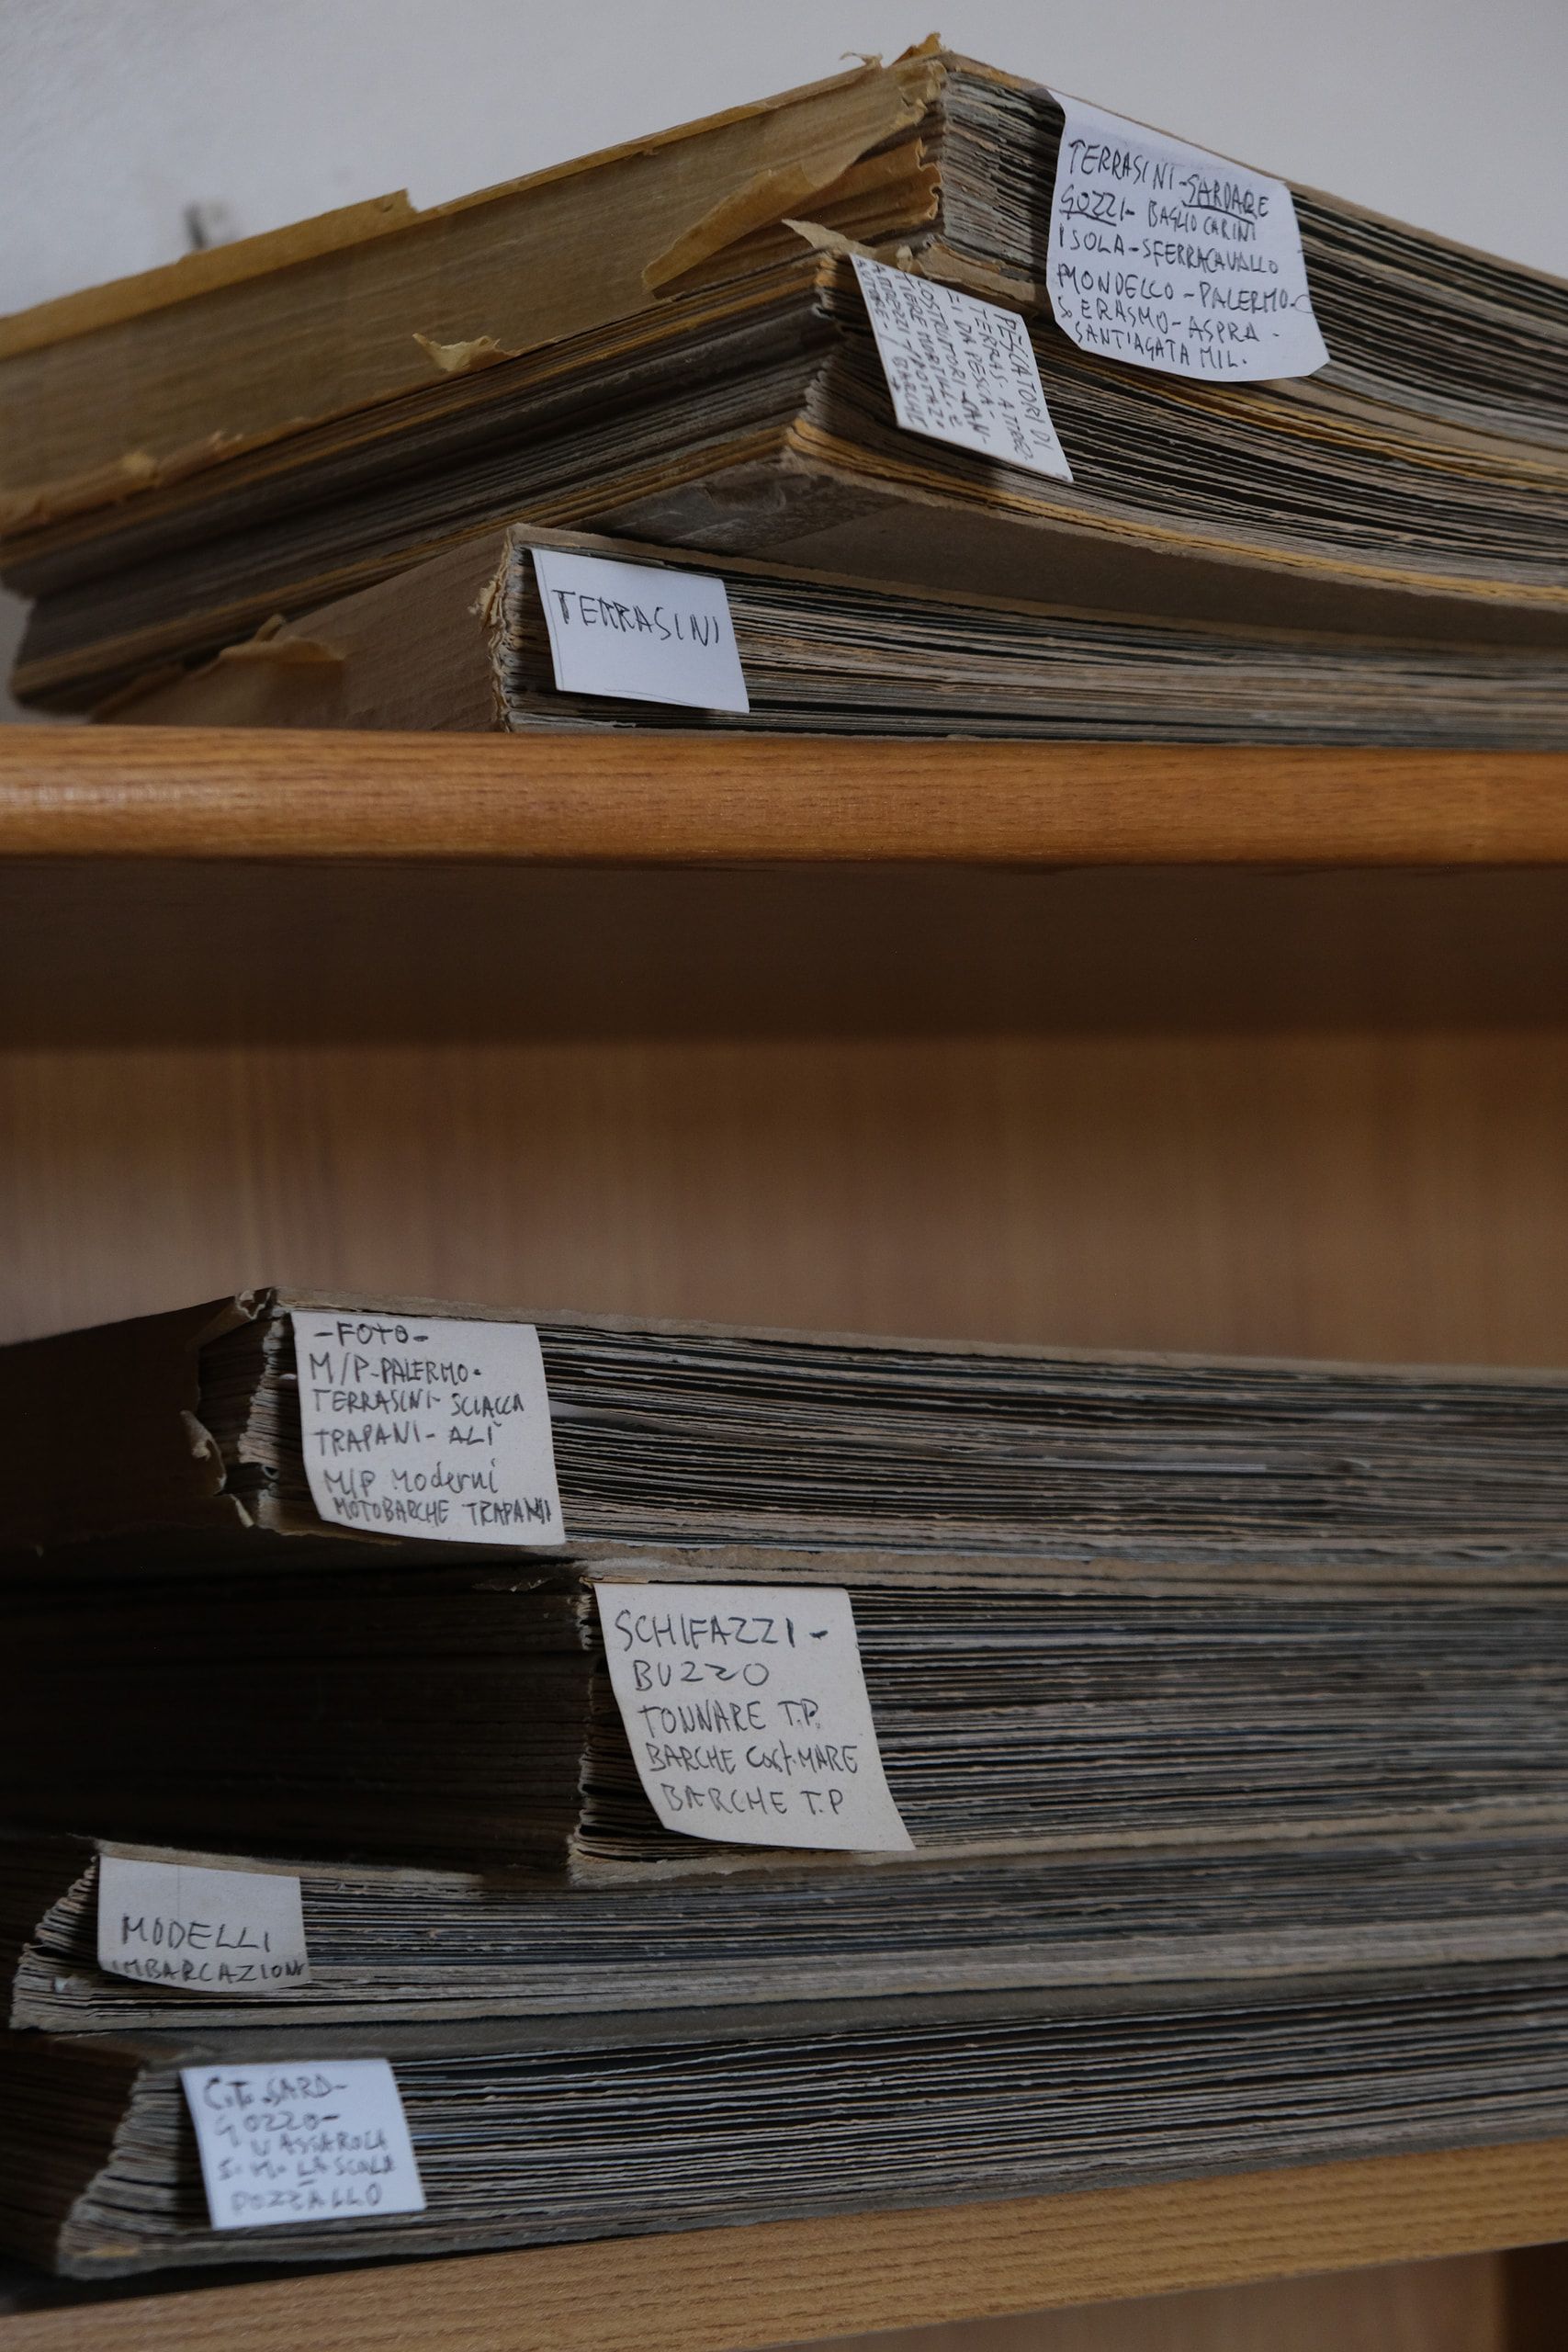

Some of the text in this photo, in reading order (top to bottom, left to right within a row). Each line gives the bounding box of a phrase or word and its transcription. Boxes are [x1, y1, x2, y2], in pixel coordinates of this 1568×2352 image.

[1148, 198, 1198, 232] BAGLIO
[1203, 216, 1256, 242] CARINI
[994, 313, 1055, 450] PESCATORI DI
[551, 589, 719, 647] TERRASINI
[450, 1393, 525, 1418] SCIACCA
[333, 1497, 450, 1527] MOTOBARCHE
[633, 1659, 770, 1691] BUZZO
[637, 1701, 766, 1737] TONNARE
[645, 1742, 736, 1774] BARCHE
[660, 1782, 788, 1815] BARCHE
[122, 1912, 270, 1953] MODELLI
